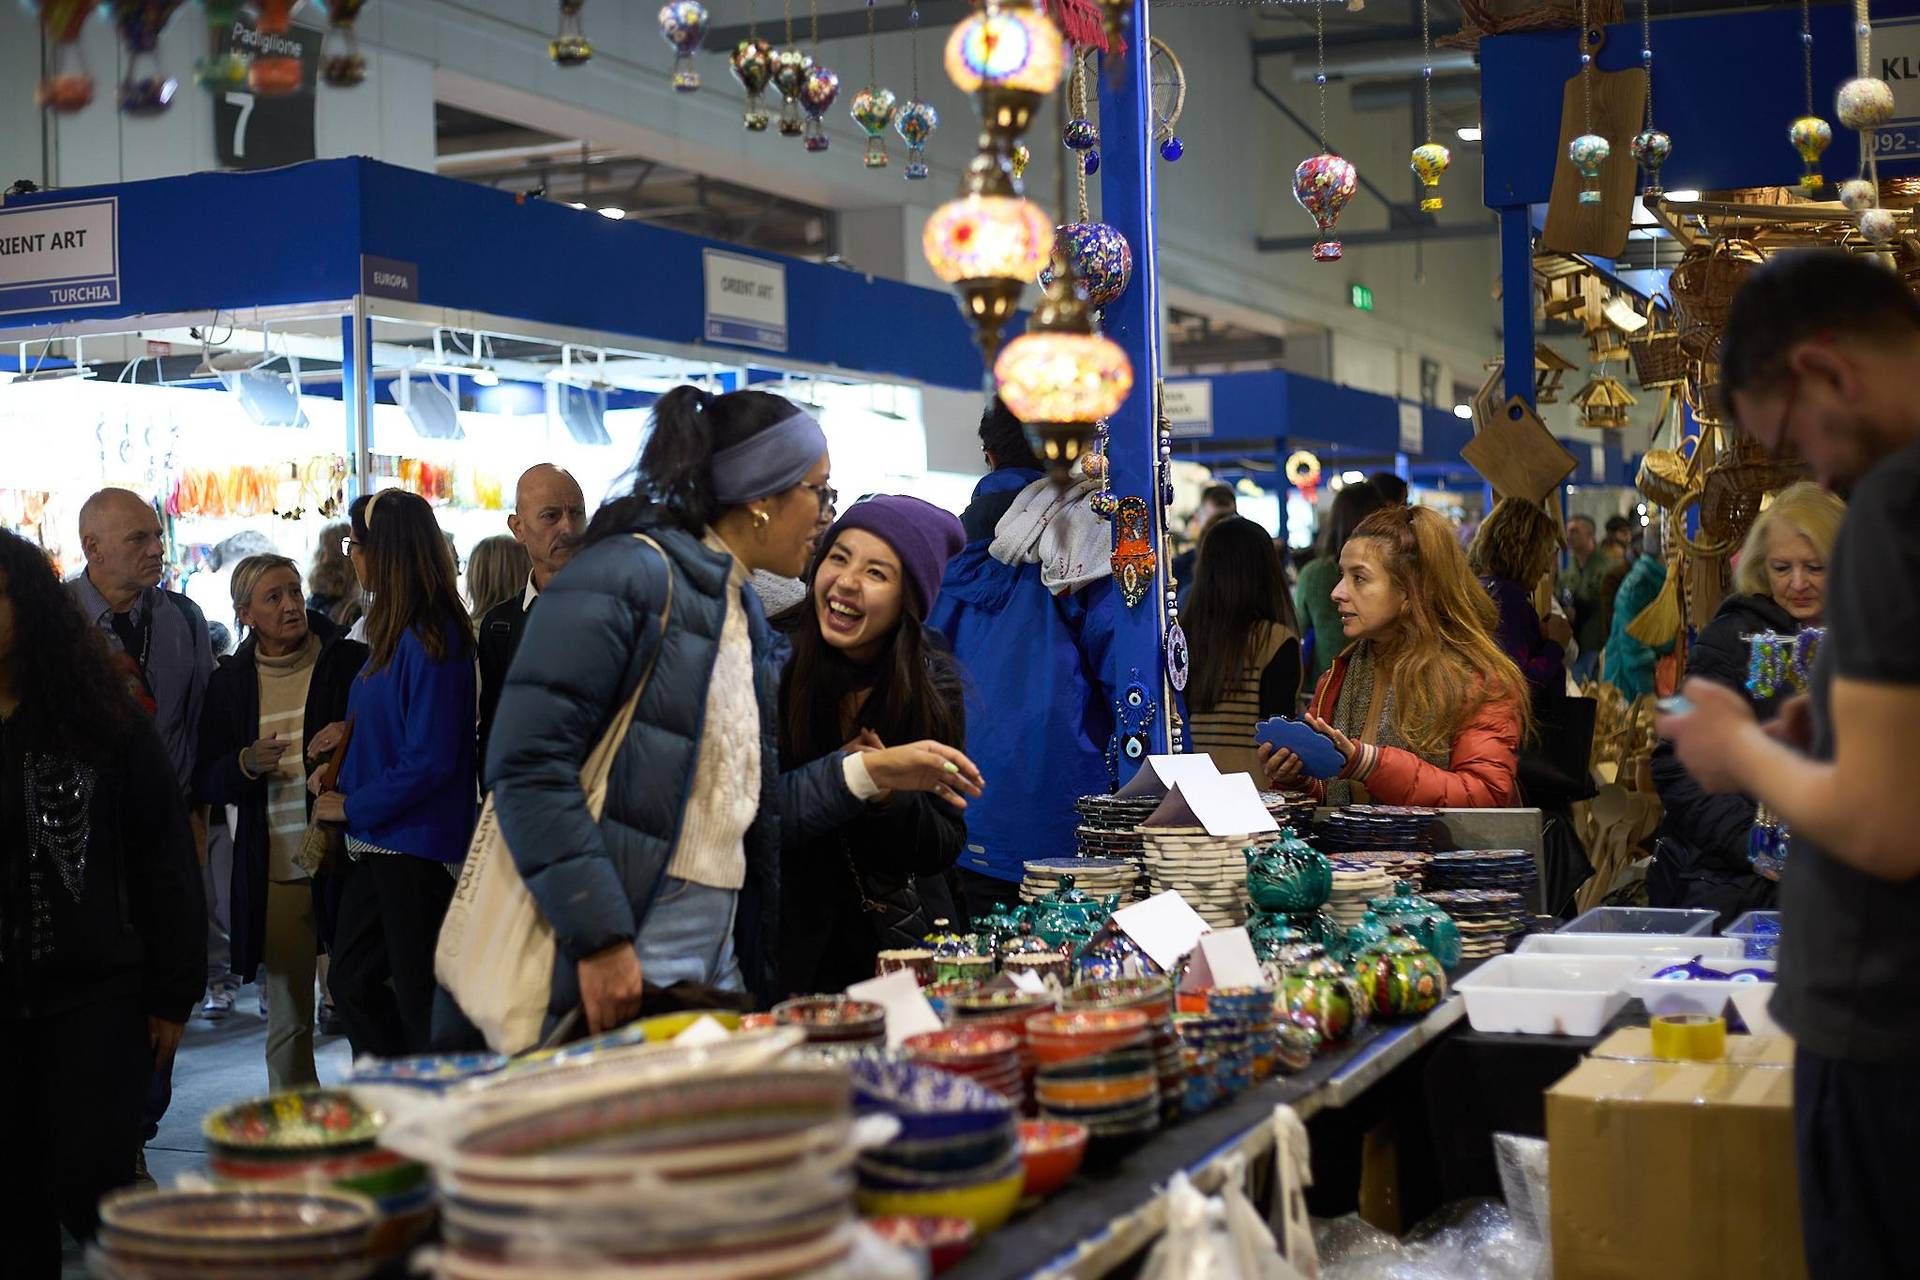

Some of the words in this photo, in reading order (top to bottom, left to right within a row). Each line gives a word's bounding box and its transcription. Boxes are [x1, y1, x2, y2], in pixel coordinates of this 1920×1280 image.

[232, 22, 302, 55] Padiglione
[1882, 56, 1920, 81] KL
[225, 92, 255, 157] 7
[50, 229, 87, 251] ART
[373, 271, 408, 290] EUROPA
[50, 285, 111, 304] TURCHIA
